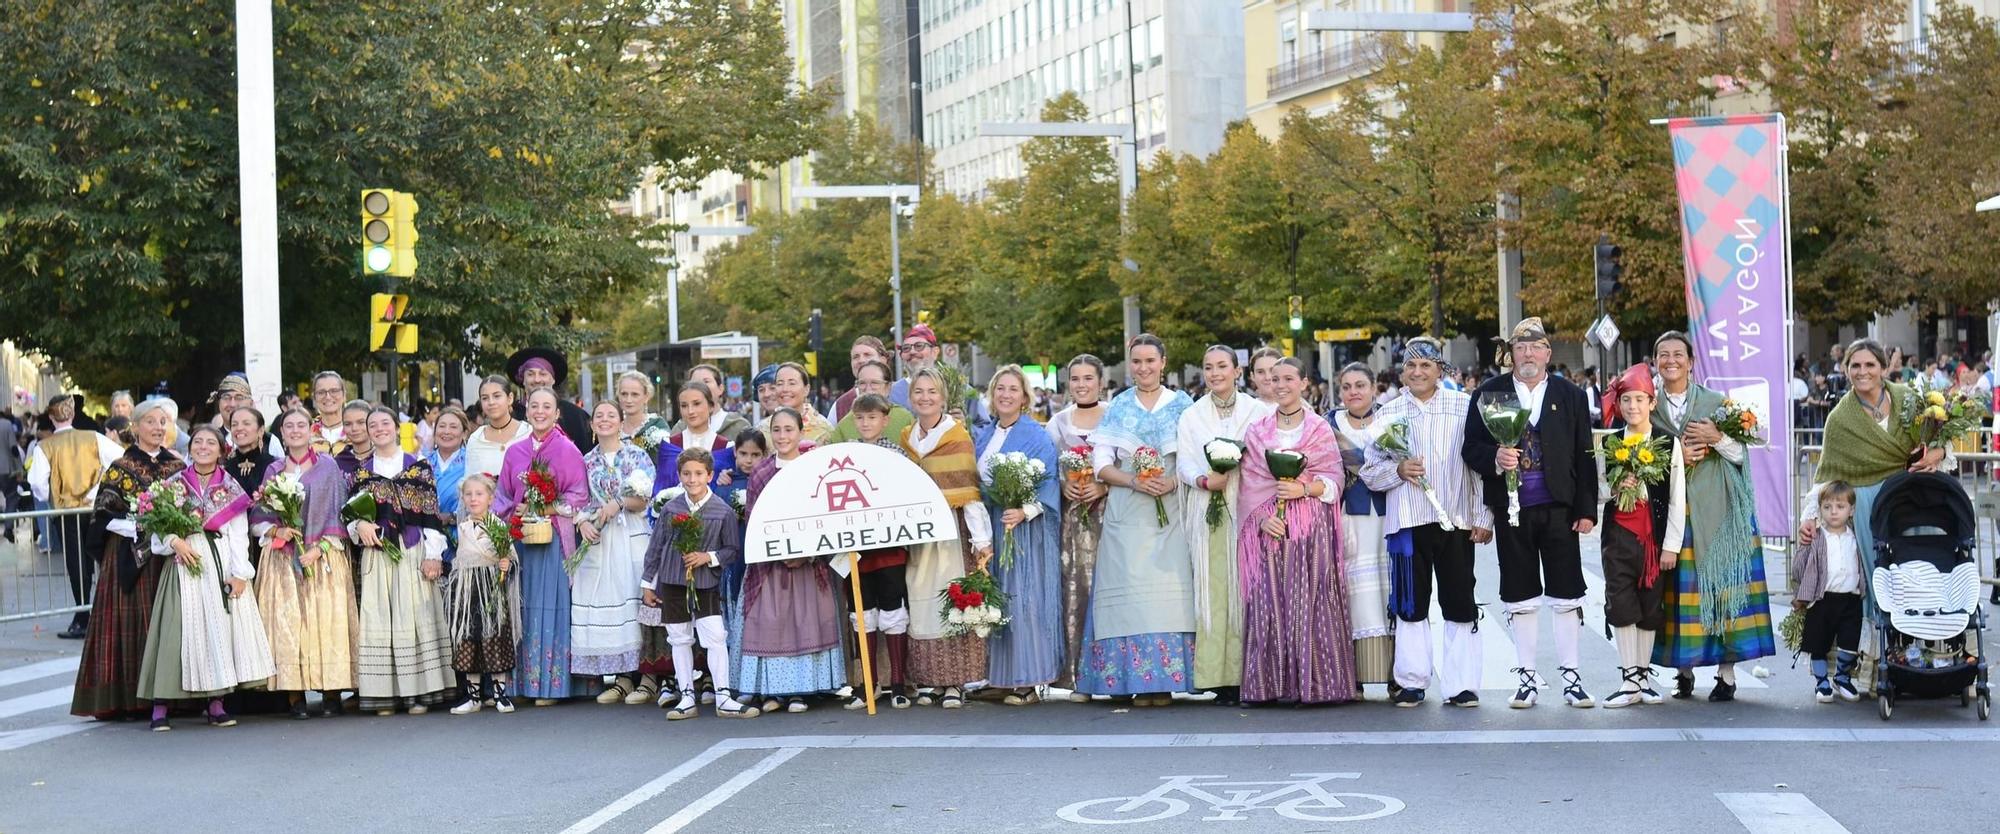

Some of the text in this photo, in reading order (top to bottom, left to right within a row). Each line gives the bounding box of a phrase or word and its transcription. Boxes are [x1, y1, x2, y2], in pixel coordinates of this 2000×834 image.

[1603, 326, 1614, 339] 30
[763, 506, 934, 535] CLUB HÍPICO
[765, 521, 936, 557] EL ABEJAR
